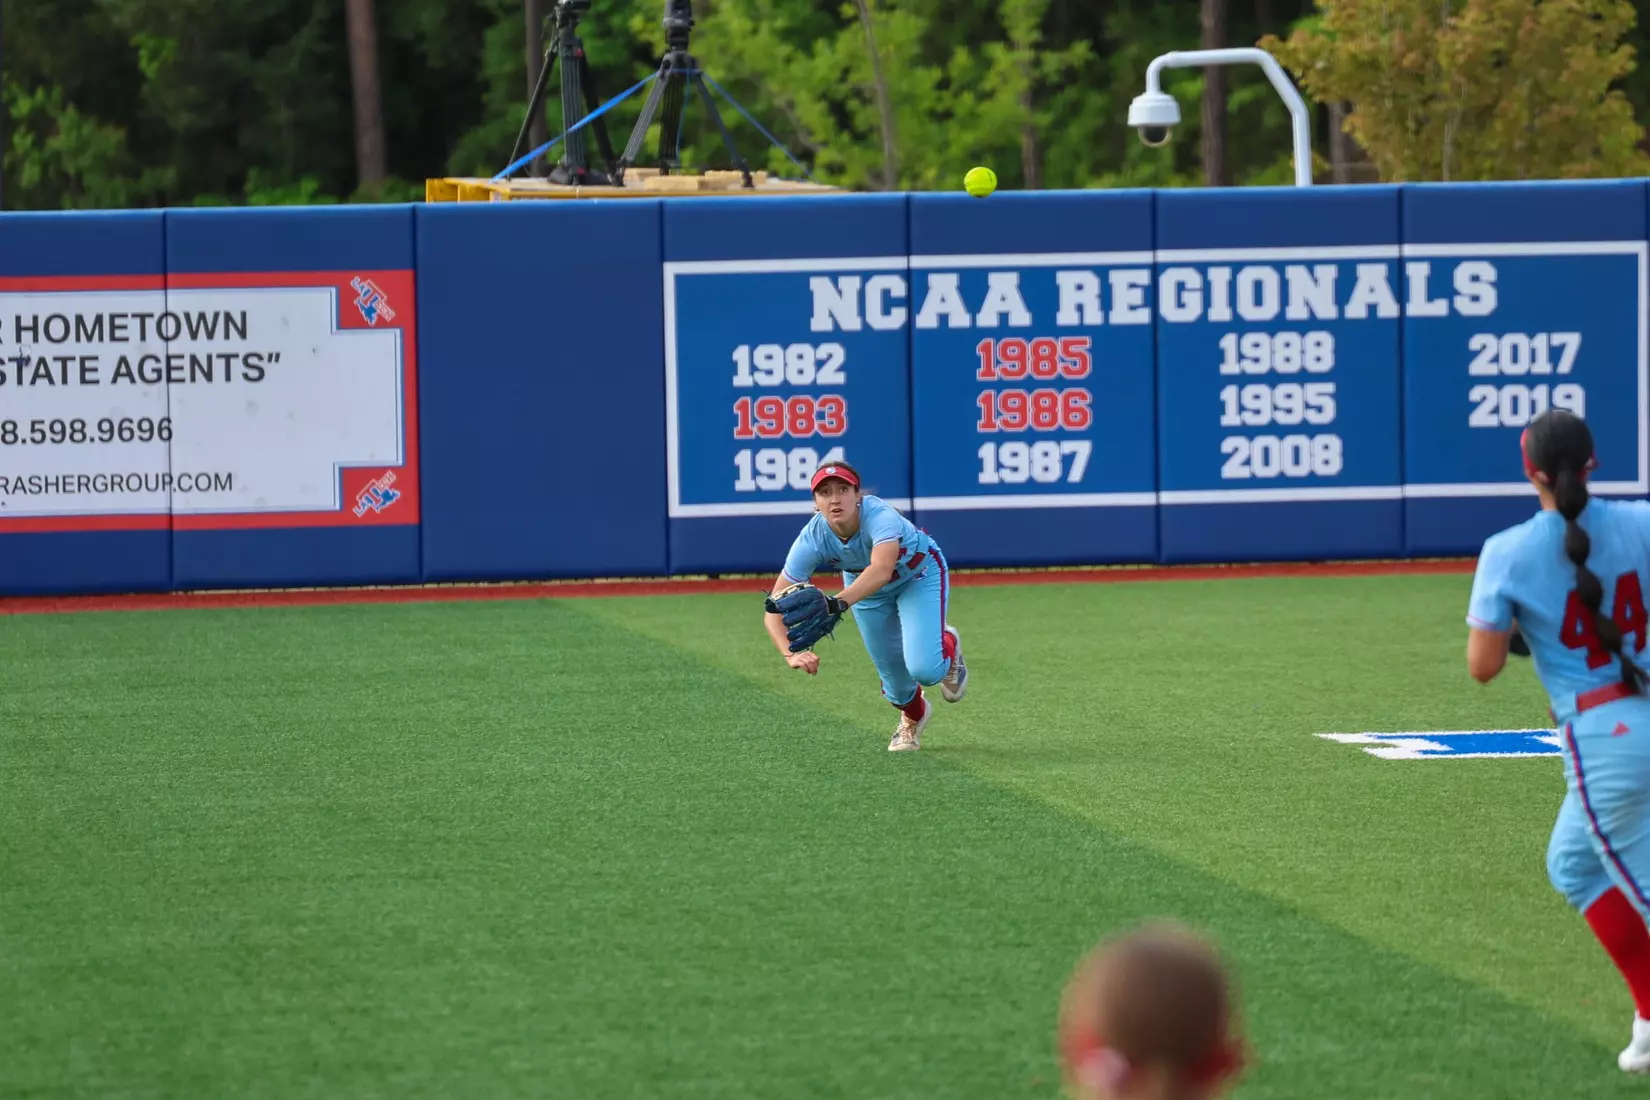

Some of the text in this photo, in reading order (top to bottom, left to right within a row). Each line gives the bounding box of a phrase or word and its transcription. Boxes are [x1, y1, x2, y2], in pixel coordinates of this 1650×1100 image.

[810, 260, 1498, 331] NCAA REGIONALS
[15, 311, 248, 345] HOMETOWN
[0, 355, 101, 387] TATE
[732, 342, 846, 387] 1982
[976, 336, 1092, 381] 1985
[1219, 331, 1335, 375] 1988
[1468, 332, 1582, 376] 2017
[733, 394, 848, 439] 1983
[976, 387, 1092, 432] 1986
[1220, 382, 1336, 426] 1995
[1468, 383, 1586, 428] 2019
[0, 417, 174, 446] 8.598.9696
[978, 440, 1092, 484] 1987
[1221, 434, 1343, 479] 2008
[1559, 569, 1649, 671] 44
